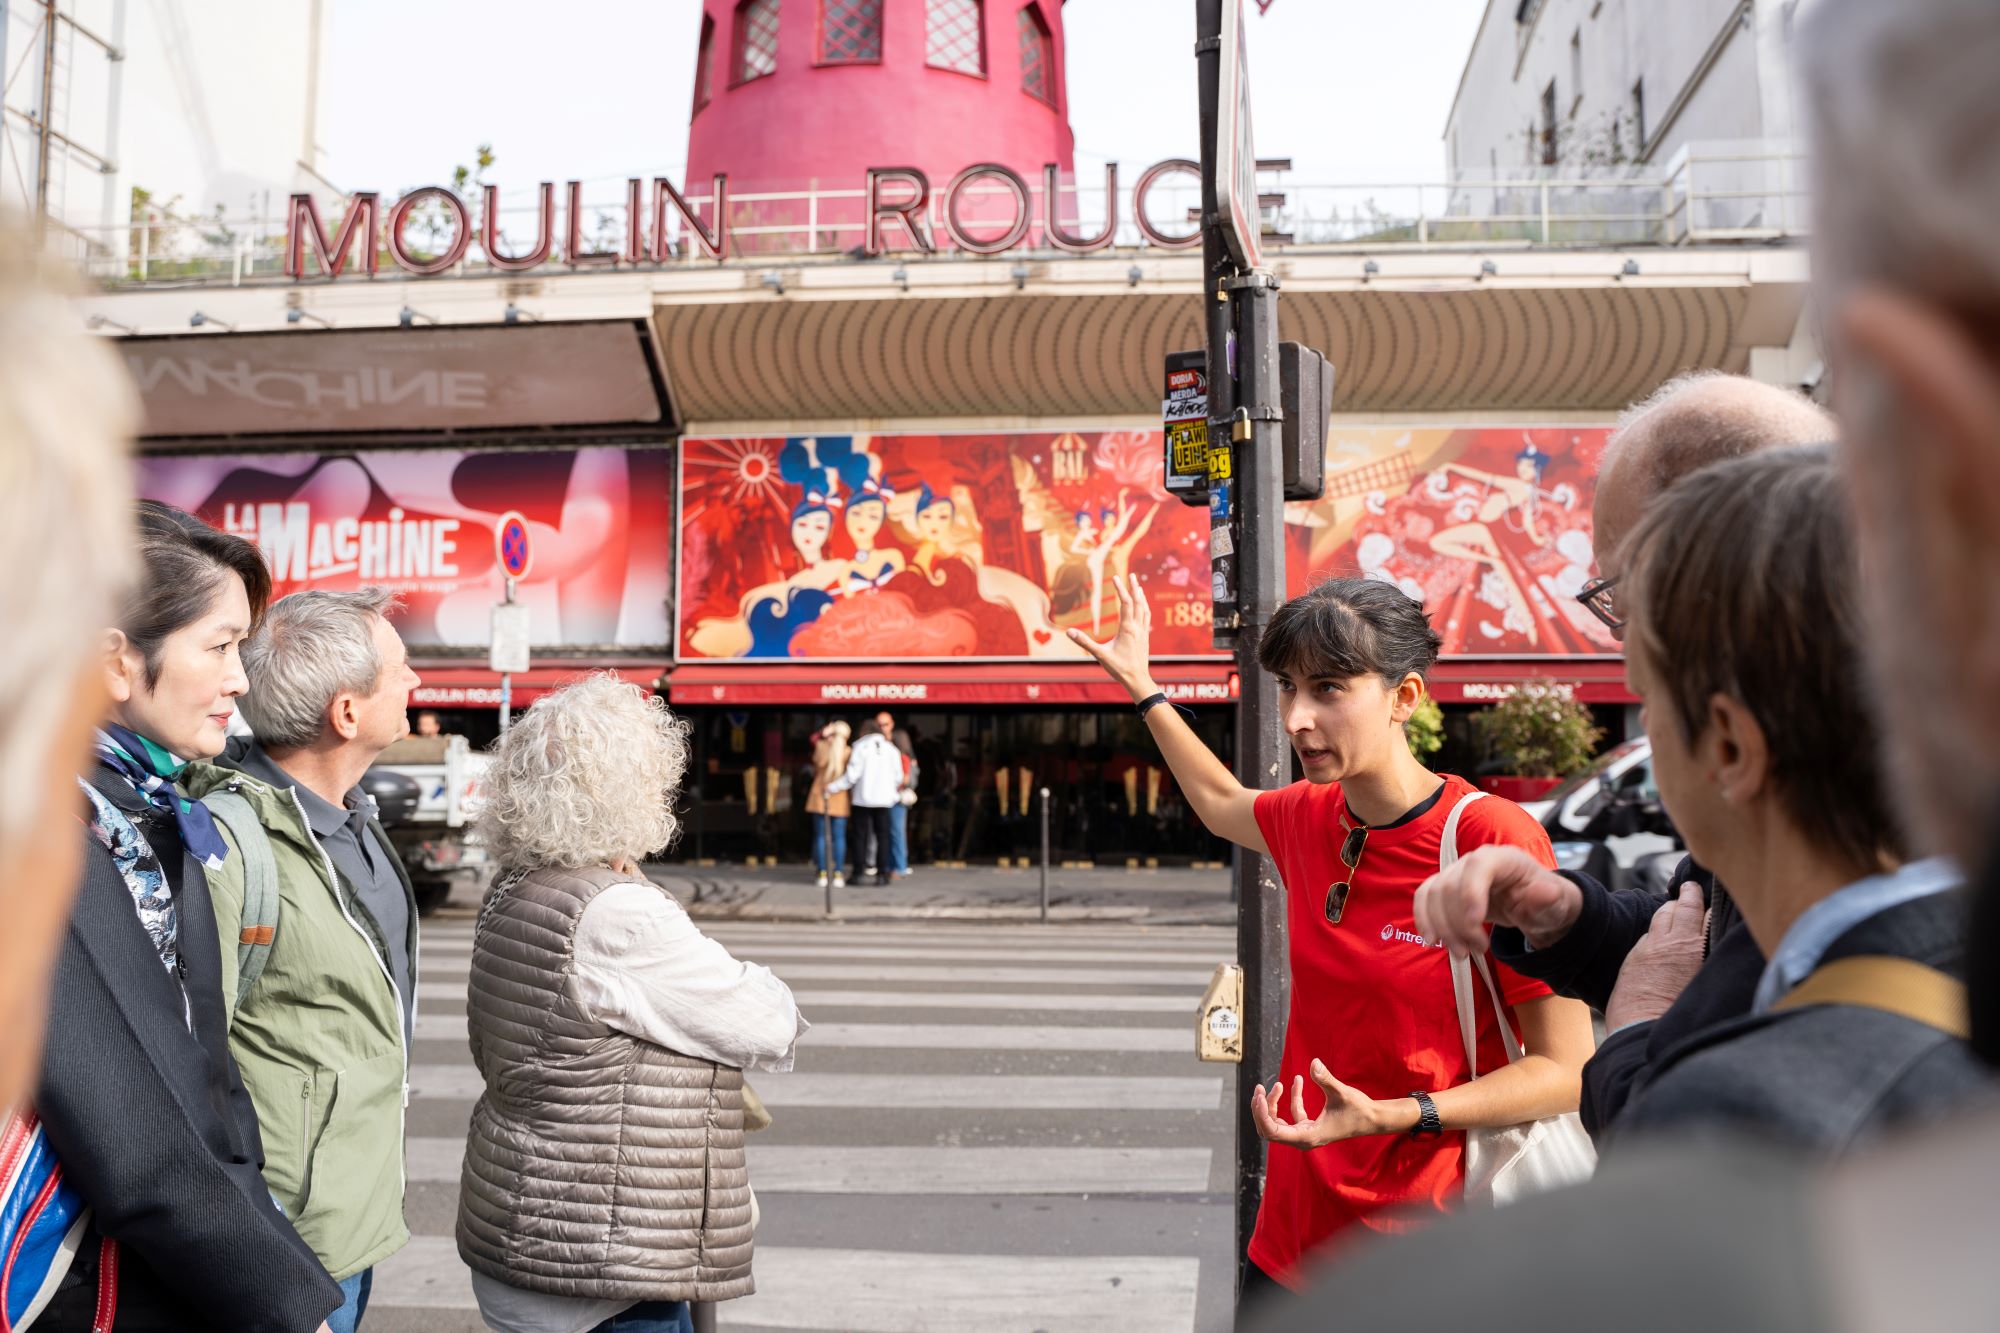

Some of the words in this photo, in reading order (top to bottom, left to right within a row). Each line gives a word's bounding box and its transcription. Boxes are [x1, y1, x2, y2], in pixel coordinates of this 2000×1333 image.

[284, 173, 727, 277] MOULIN
[1171, 372, 1194, 386] DORIA
[1170, 387, 1198, 401] MERDA
[1053, 450, 1089, 481] BAL
[224, 503, 258, 532] LA
[413, 688, 465, 703] MOULIN
[821, 685, 876, 698] MOULIN
[877, 685, 928, 698] ROUGE
